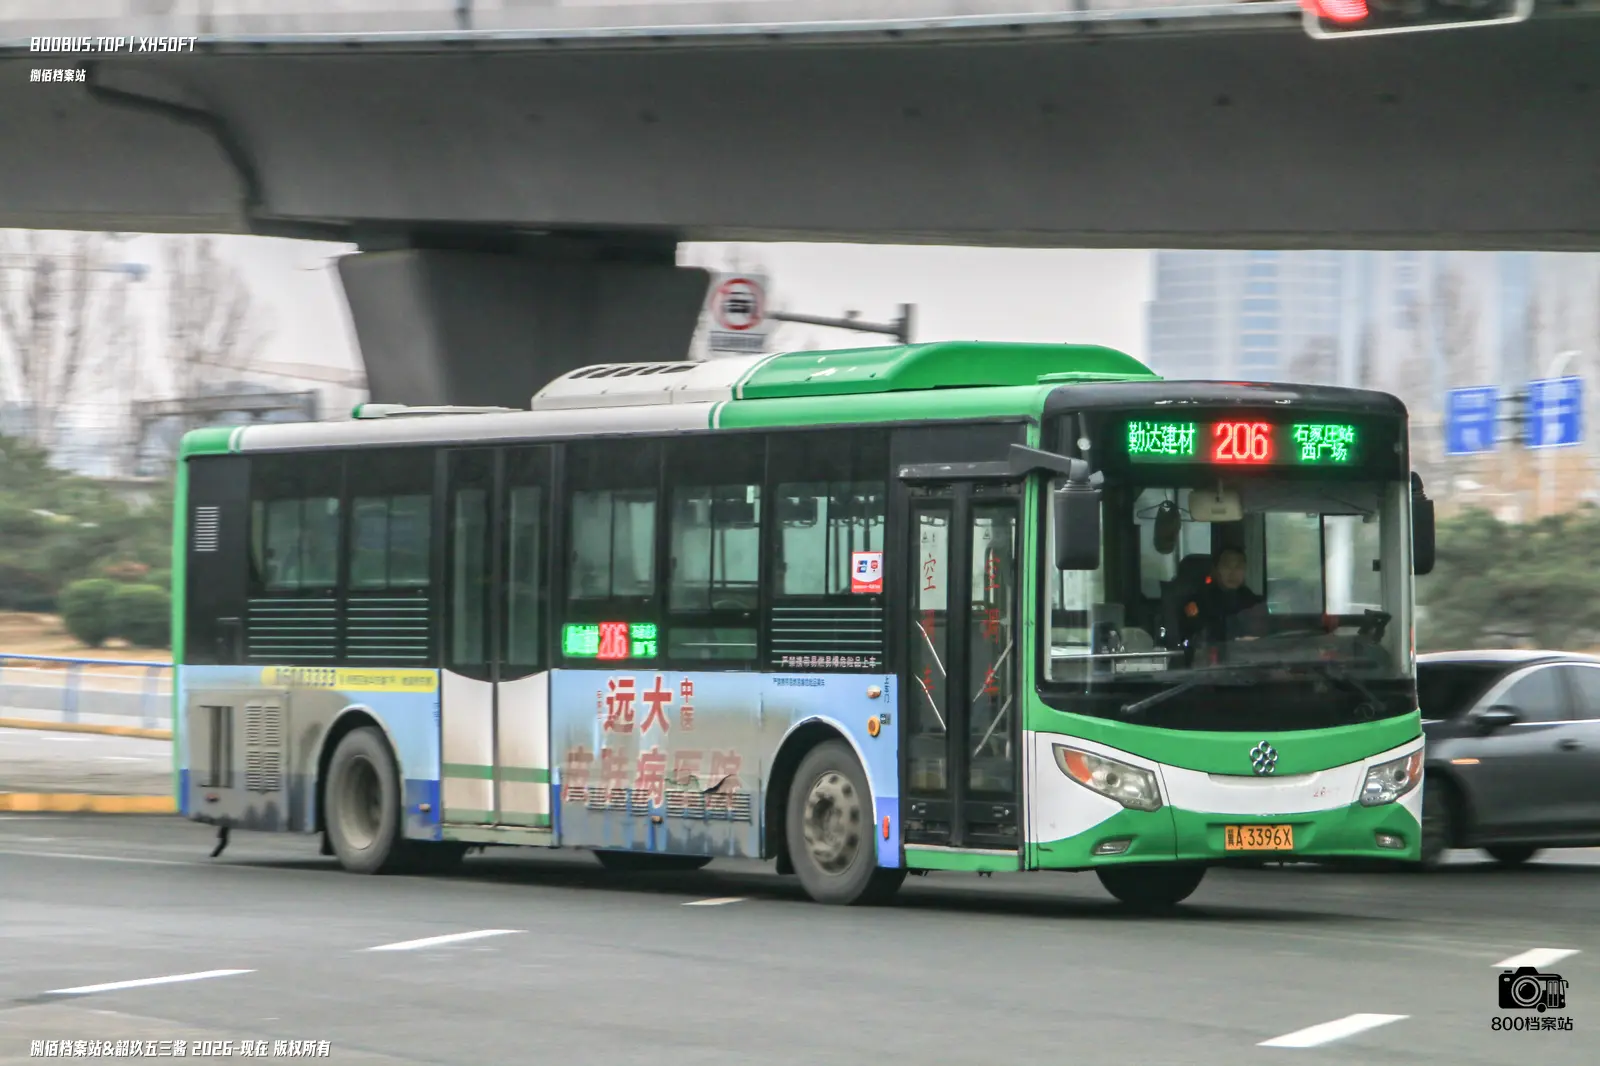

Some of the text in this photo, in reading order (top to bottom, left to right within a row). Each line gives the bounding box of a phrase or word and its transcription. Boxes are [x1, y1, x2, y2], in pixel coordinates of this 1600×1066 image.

[1127, 421, 1196, 455] 勤达建材
[1215, 422, 1270, 461] 206
[1301, 442, 1348, 461] 西广场
[599, 622, 629, 658] 206
[602, 675, 674, 735] 远大
